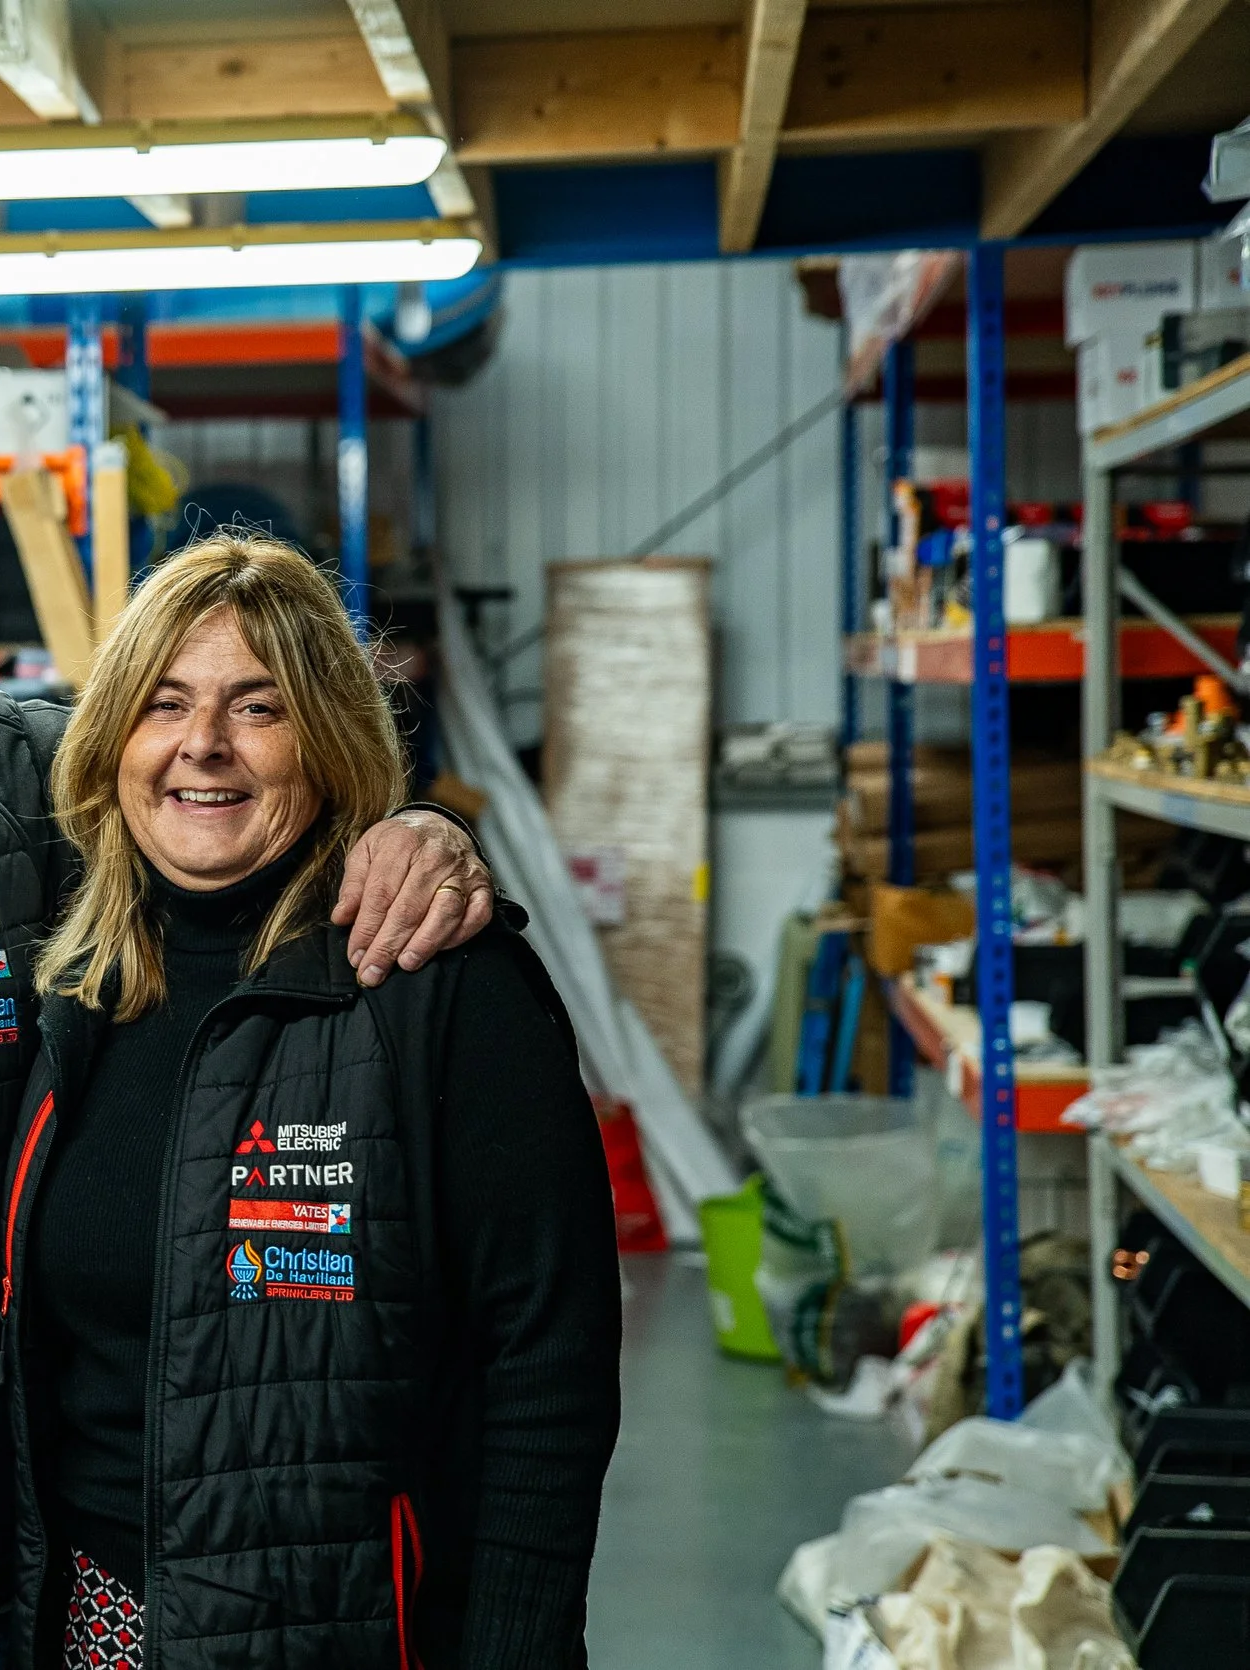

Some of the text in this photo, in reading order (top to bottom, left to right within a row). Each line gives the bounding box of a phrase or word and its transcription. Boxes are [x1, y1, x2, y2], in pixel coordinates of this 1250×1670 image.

[277, 1137, 342, 1152] ELECTRIC
[231, 1161, 354, 1187] PARTNER
[292, 1204, 328, 1218] YATES
[265, 1246, 353, 1273] Christian
[266, 1269, 354, 1286] De Havilland
[266, 1287, 354, 1301] SPRINKLERS LTD
